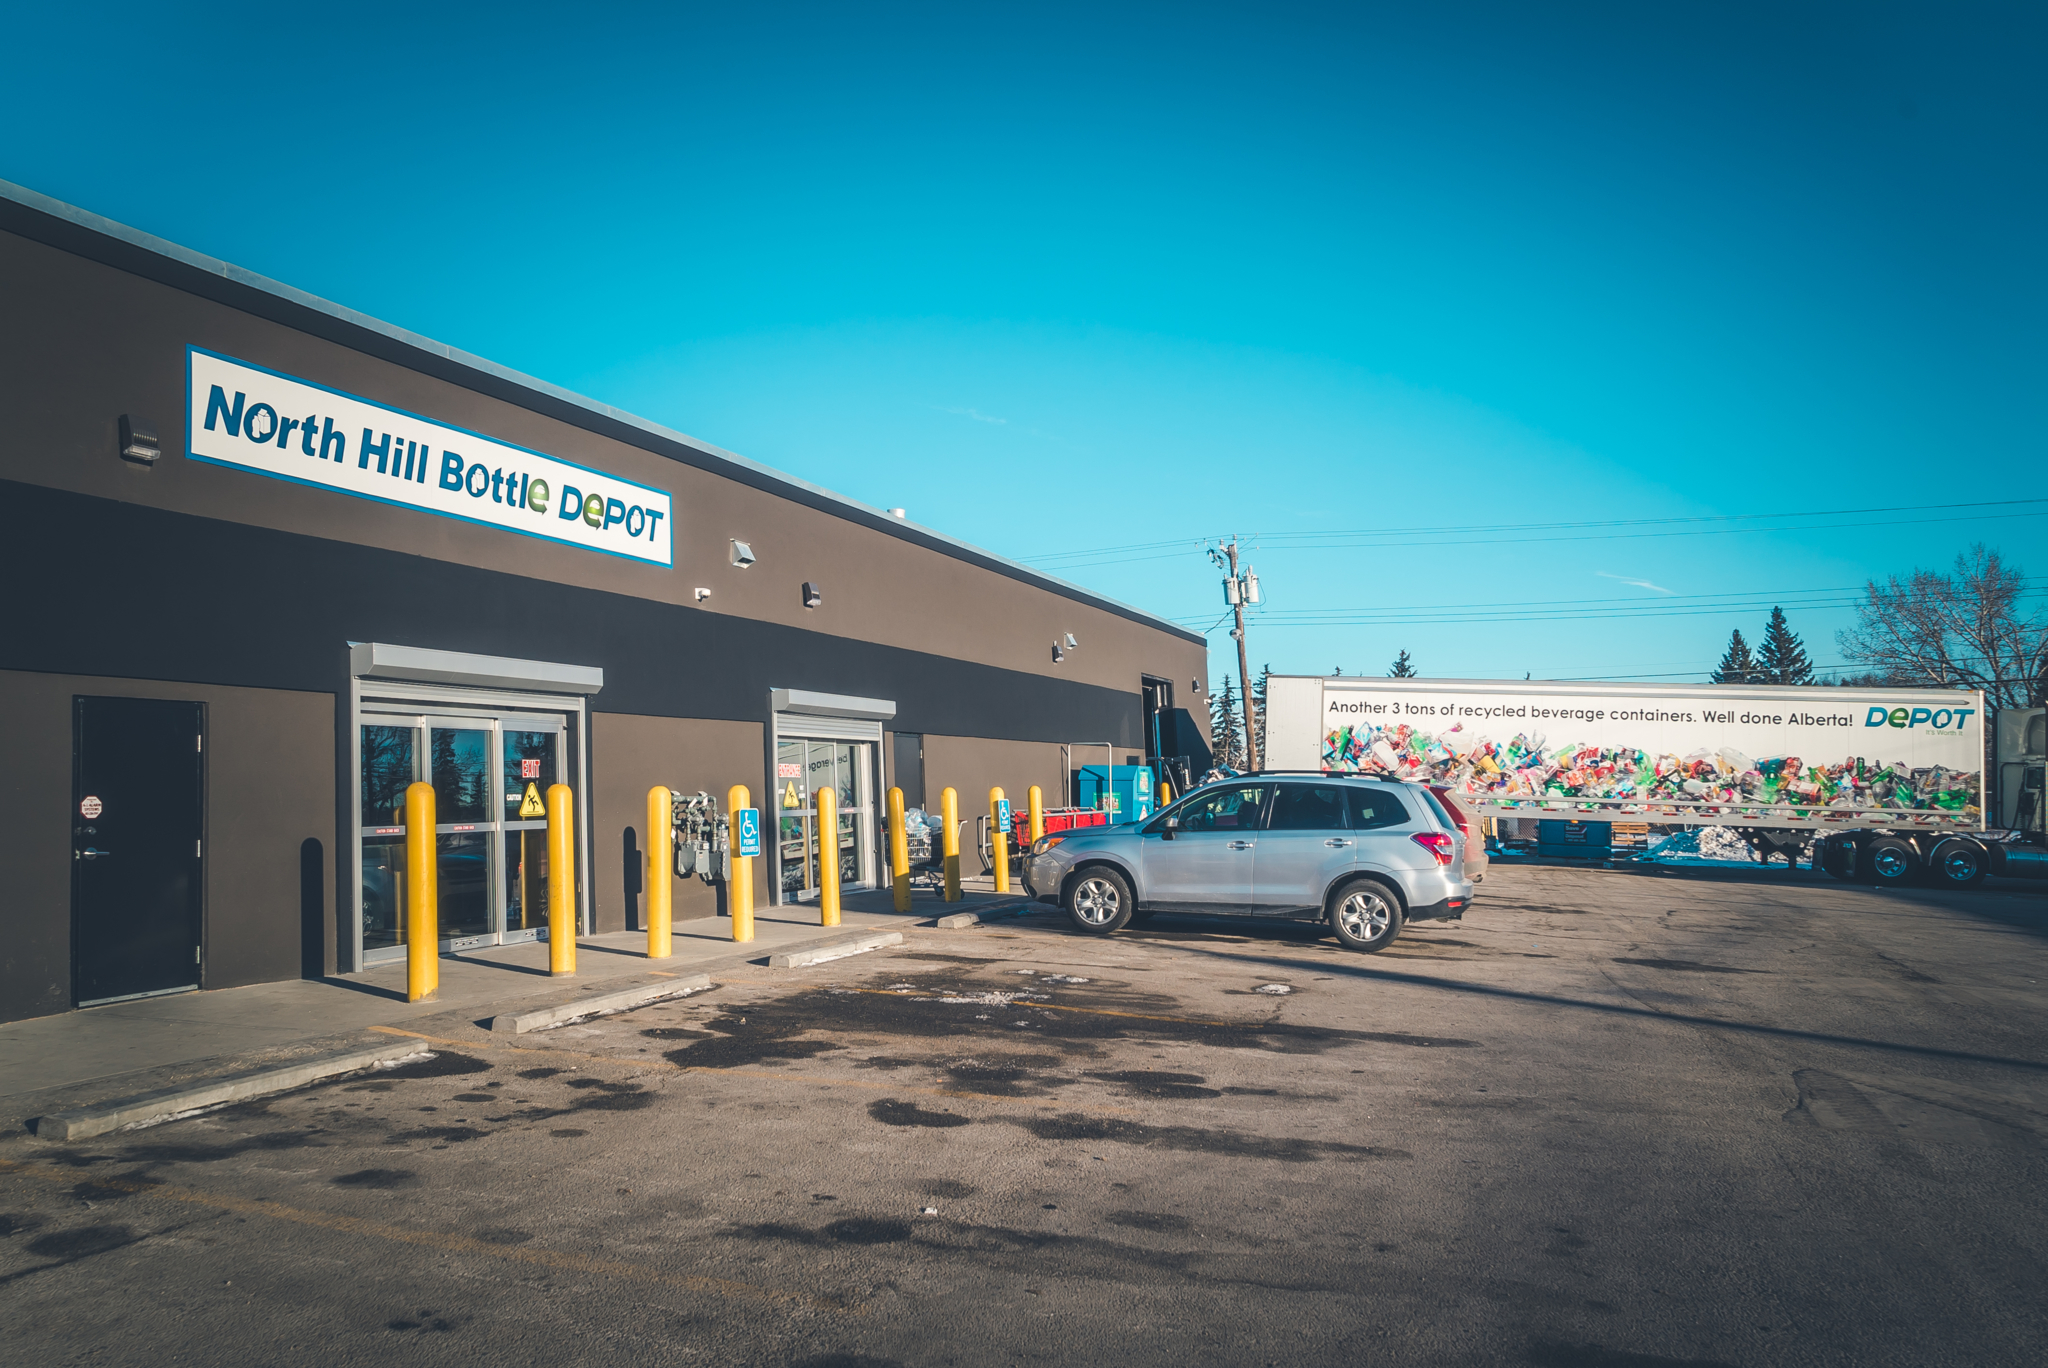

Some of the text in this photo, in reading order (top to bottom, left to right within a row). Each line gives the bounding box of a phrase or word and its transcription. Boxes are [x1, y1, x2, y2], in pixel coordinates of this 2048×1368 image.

[203, 384, 346, 463] North
[358, 428, 429, 484] Hill
[439, 450, 549, 515] Bottle
[1328, 701, 1854, 727] Another 3 tons of recycled beverage containers. Well done Alberta!
[522, 759, 540, 778] EXIT
